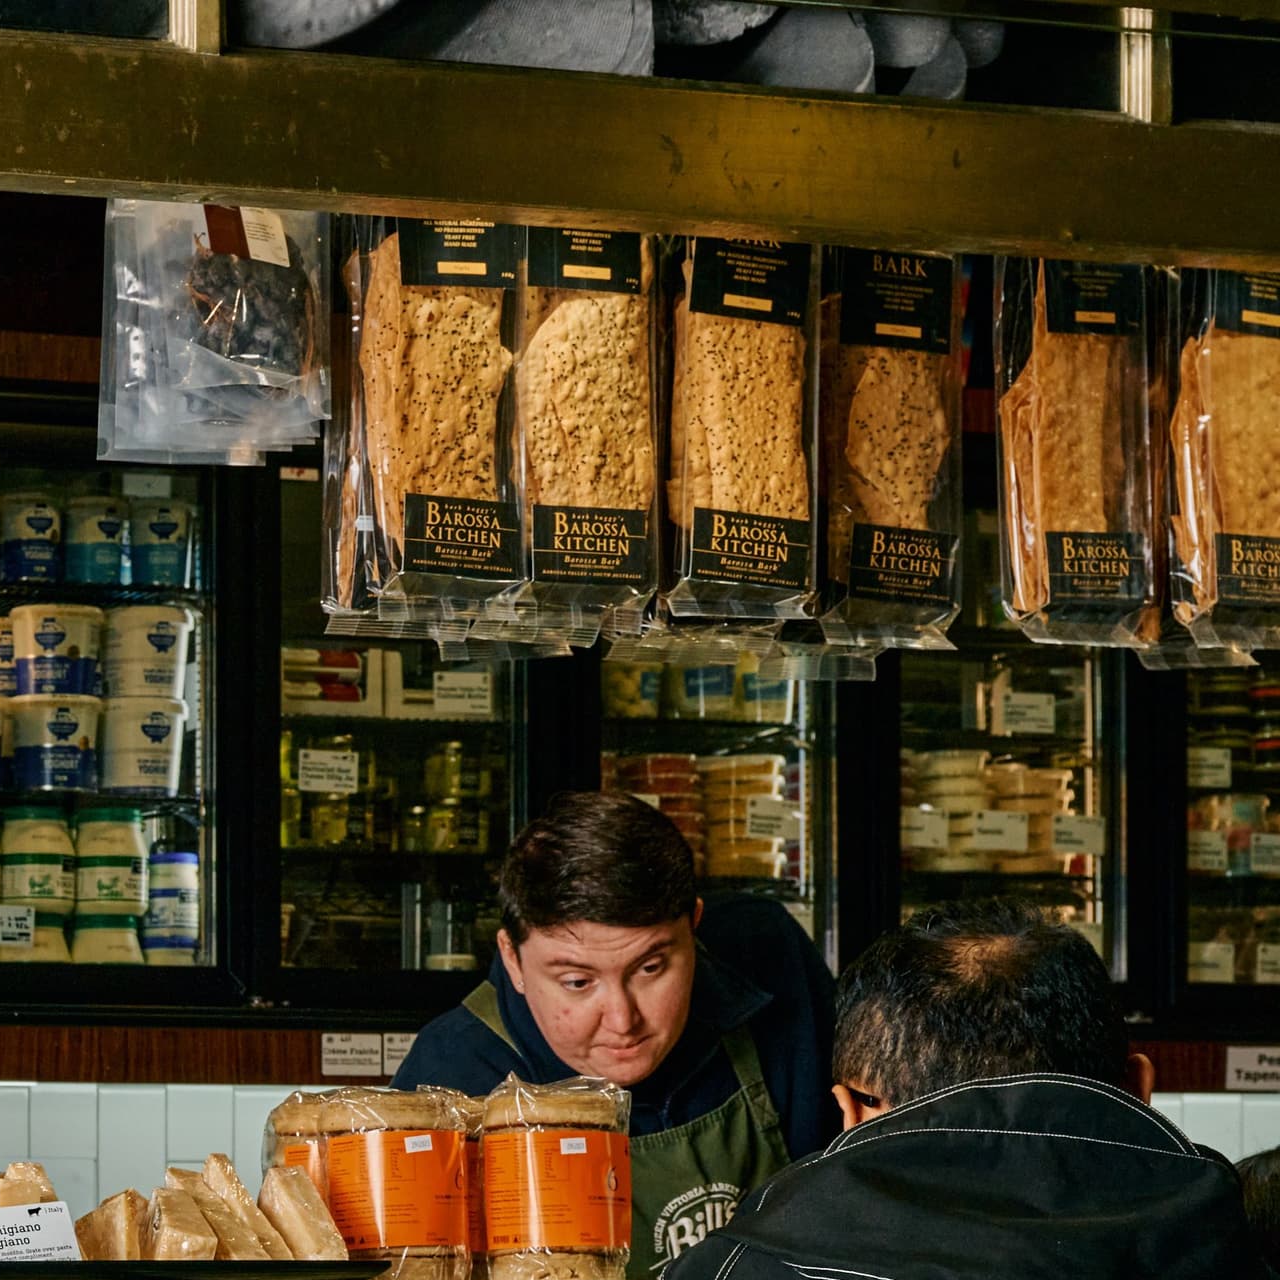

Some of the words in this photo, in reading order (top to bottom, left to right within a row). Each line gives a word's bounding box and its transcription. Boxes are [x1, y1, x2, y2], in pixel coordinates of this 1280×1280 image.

[873, 254, 927, 278] BARK
[426, 501, 501, 530] BAROSSA
[554, 512, 629, 538] BAROSSA
[425, 526, 501, 549] KITCHEN
[554, 537, 629, 556] KITCHEN
[872, 530, 941, 559] BAROSSA
[870, 555, 941, 577] KITCHEN
